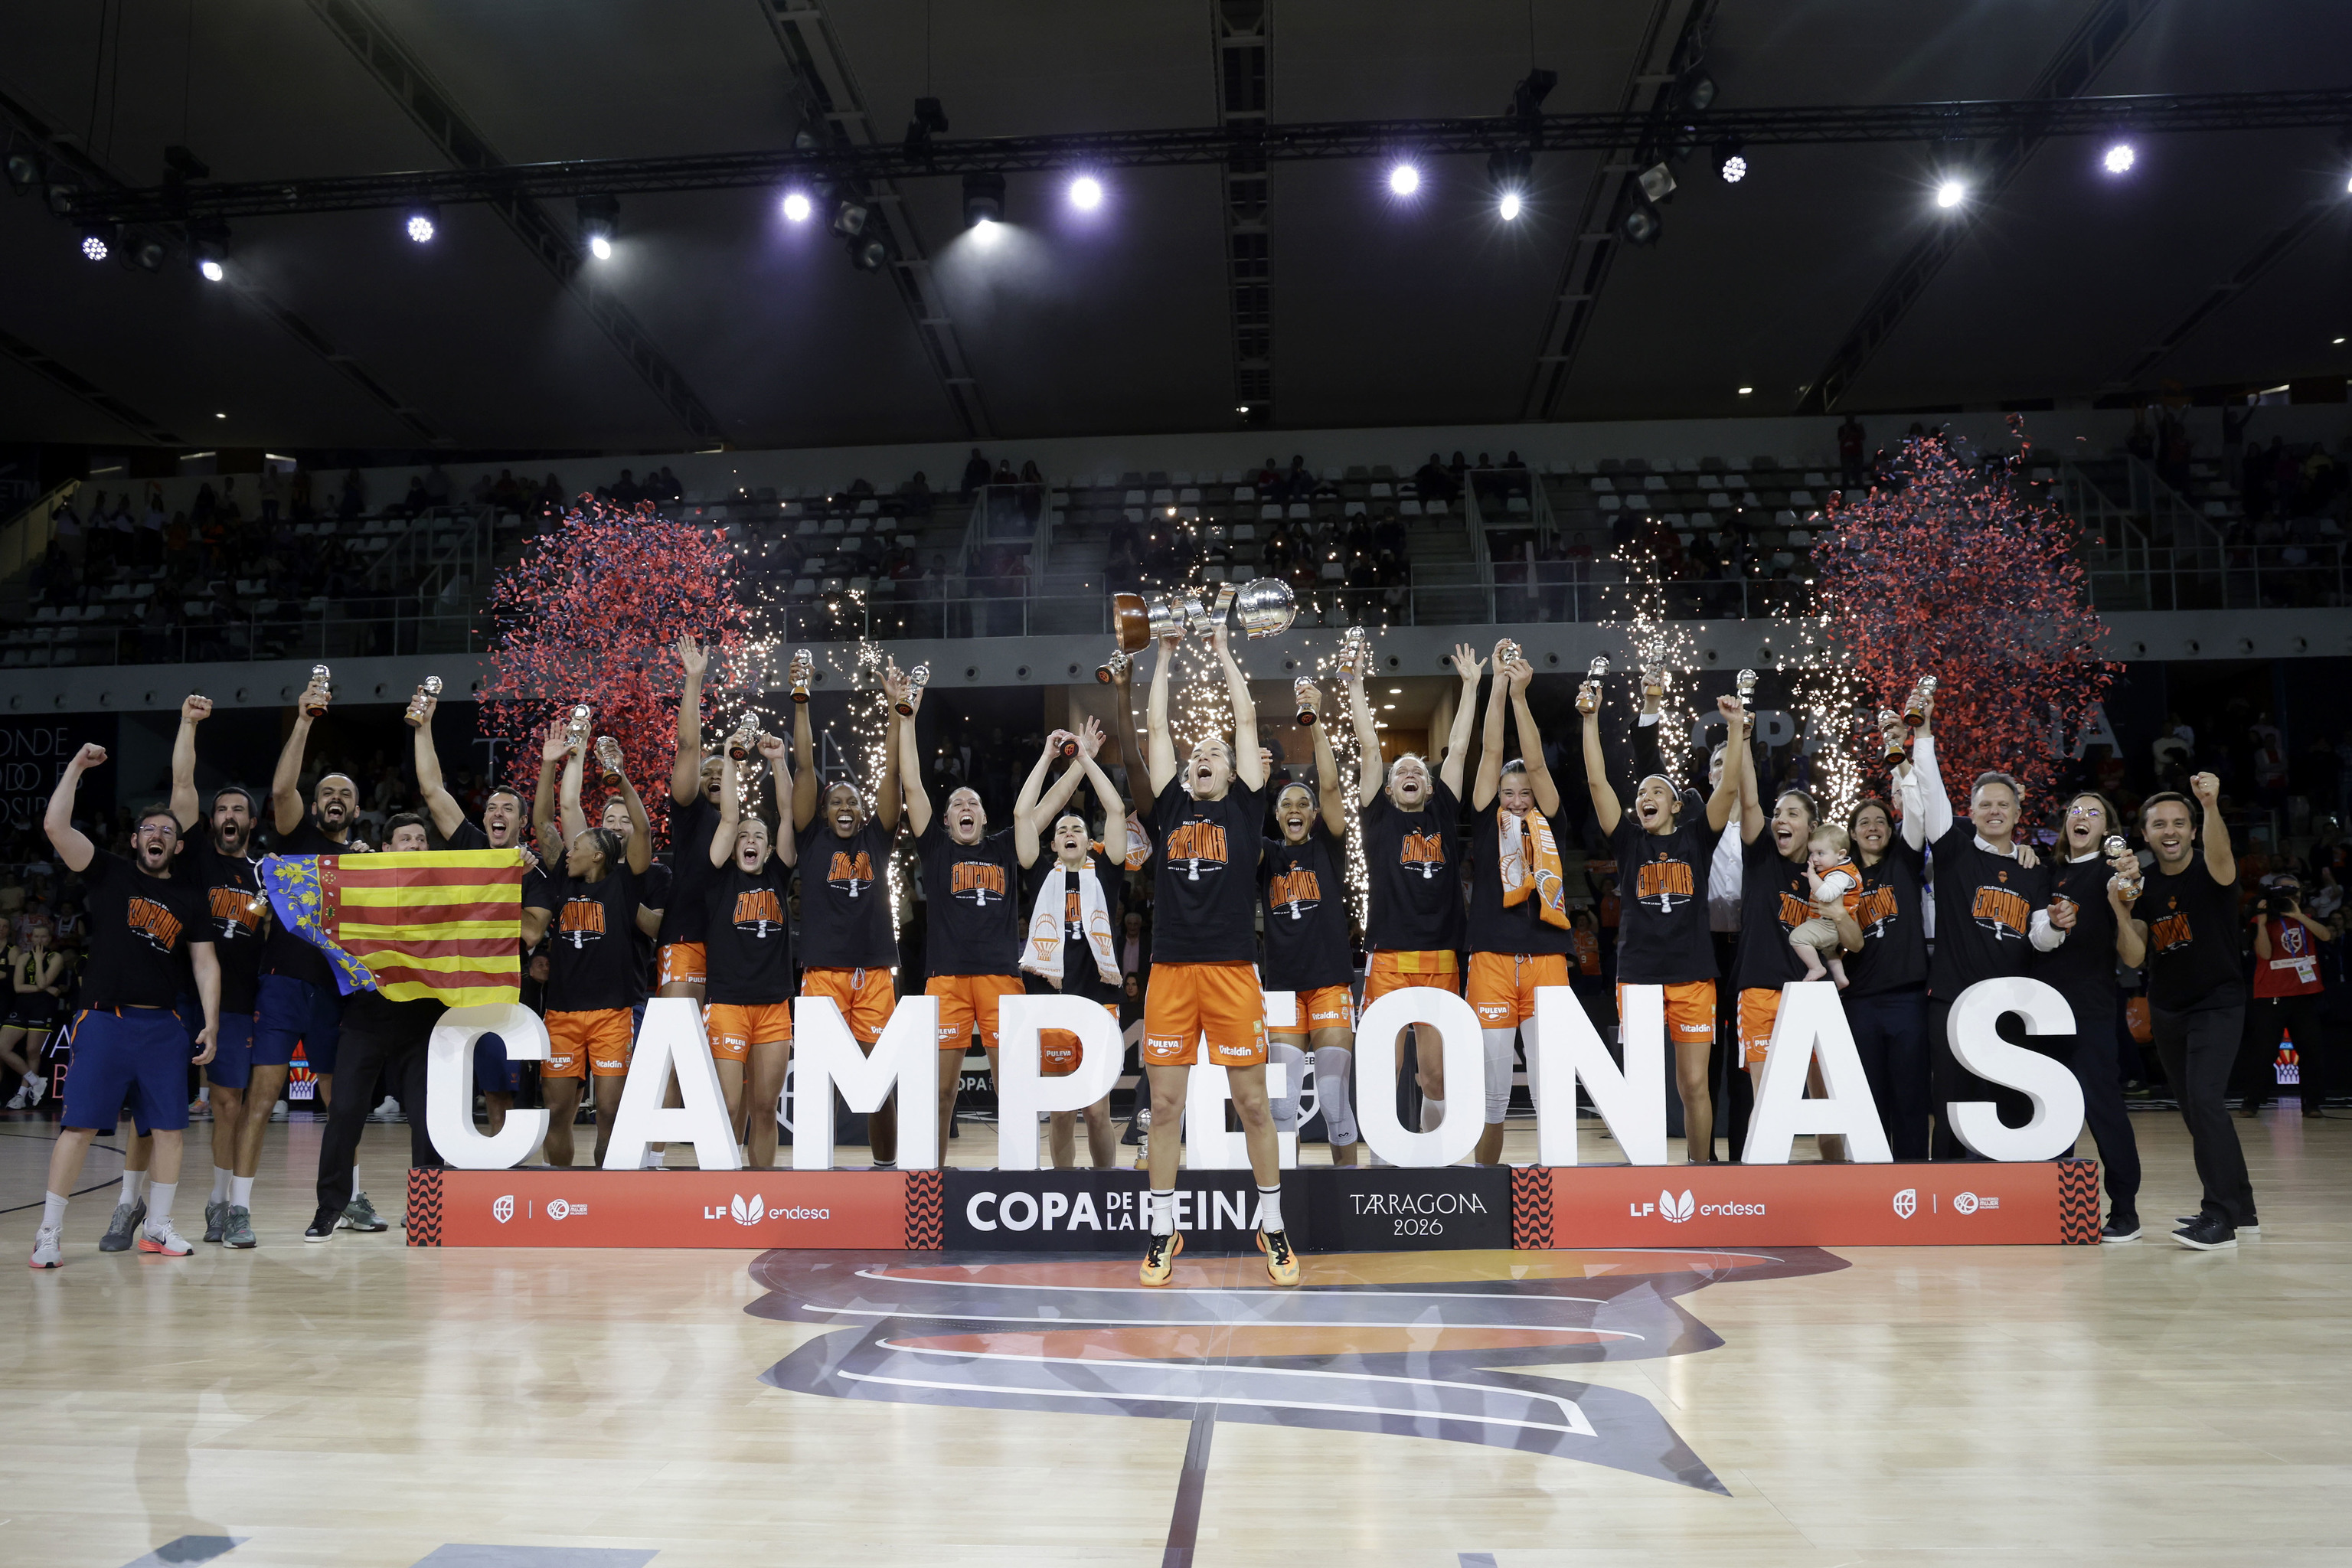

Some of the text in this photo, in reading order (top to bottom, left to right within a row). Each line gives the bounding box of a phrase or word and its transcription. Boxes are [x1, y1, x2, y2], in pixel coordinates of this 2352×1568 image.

[1312, 1011, 1339, 1021] Vitaldin
[1680, 1024, 1711, 1033] Vitaldin
[1148, 1038, 1179, 1048] PULEVA
[1218, 1045, 1253, 1056] Vitaldin
[1106, 1191, 1132, 1210] DE
[1349, 1193, 1488, 1214] TARRAGONA
[1630, 1200, 1766, 1217] LF endesa
[704, 1205, 830, 1220] LF endesa
[965, 1191, 1103, 1231] COPA
[1106, 1212, 1135, 1230] LA
[1393, 1218, 1443, 1236] 2026
